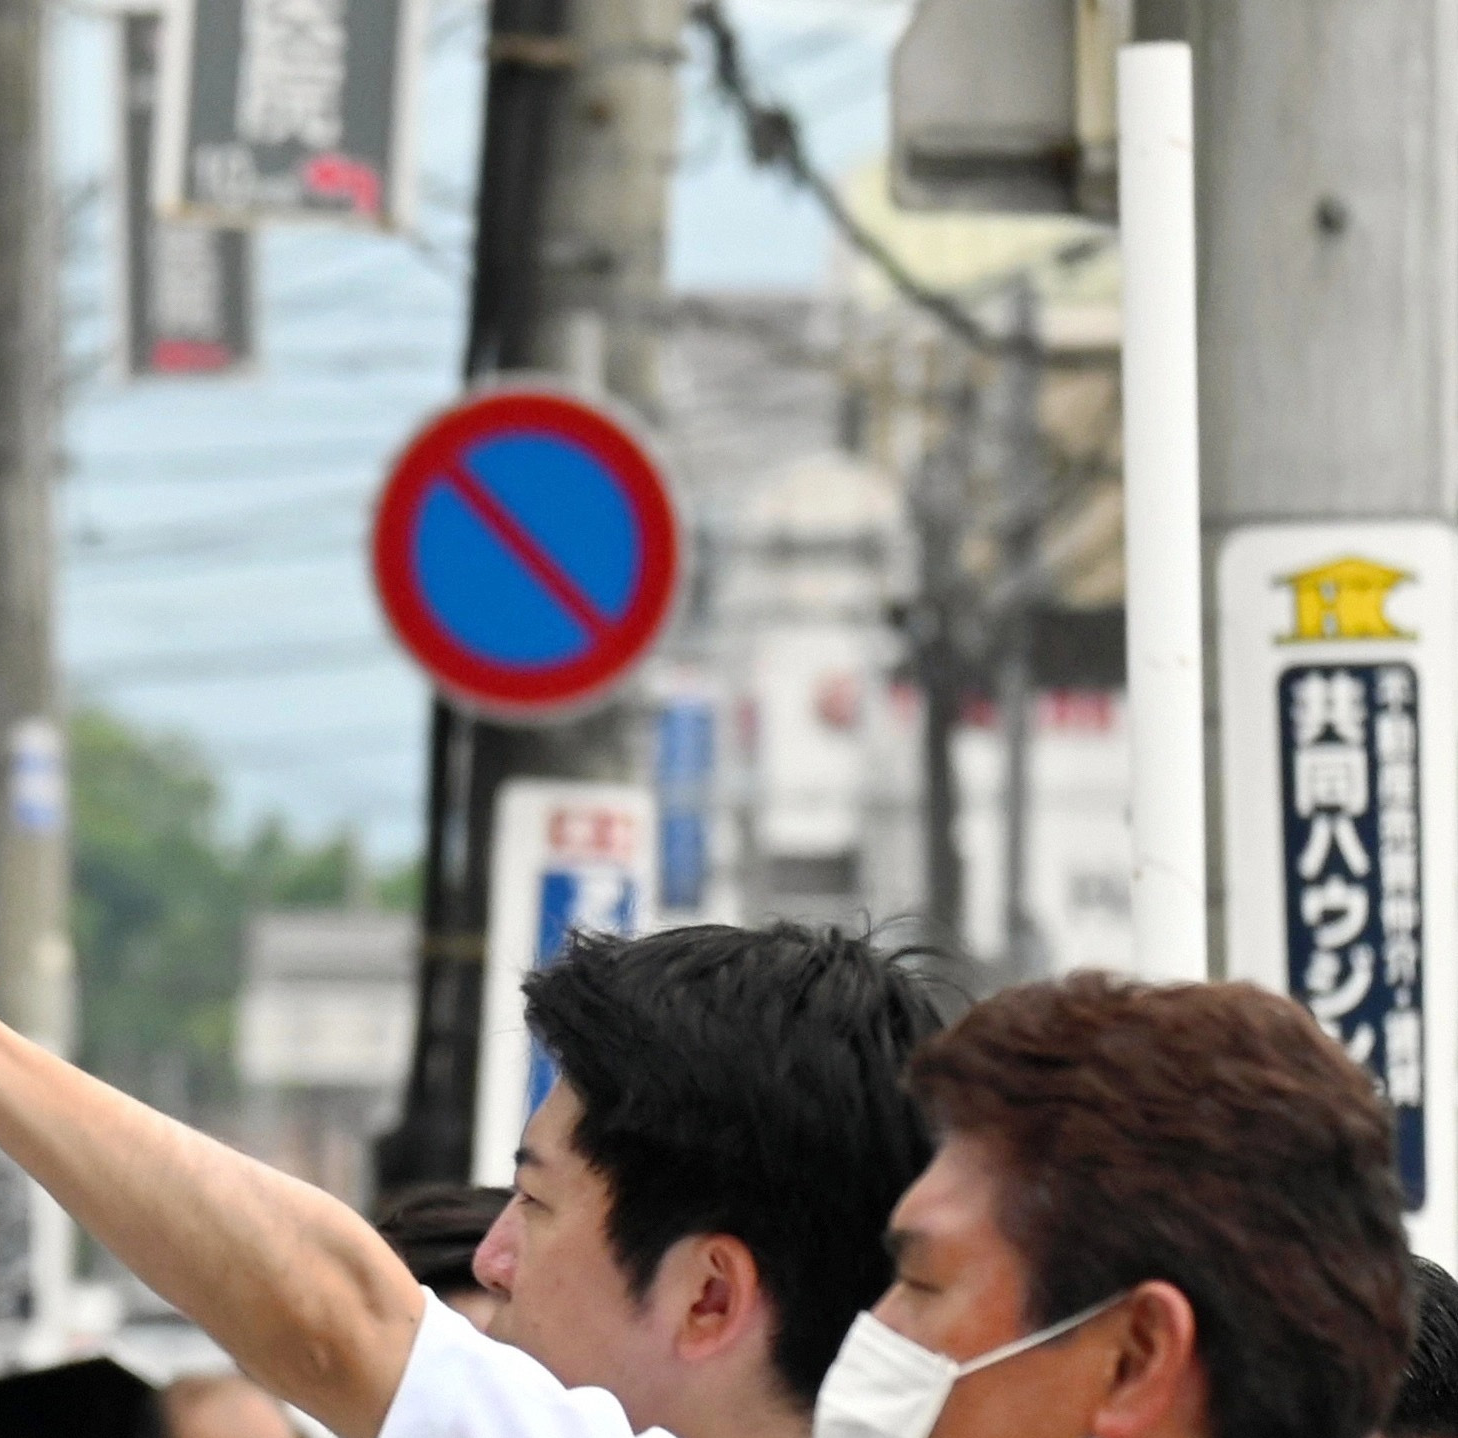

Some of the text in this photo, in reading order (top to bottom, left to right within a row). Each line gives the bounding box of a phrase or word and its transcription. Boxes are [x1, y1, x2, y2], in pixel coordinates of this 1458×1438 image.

[1290, 666, 1386, 1097] 共同ハウジン
